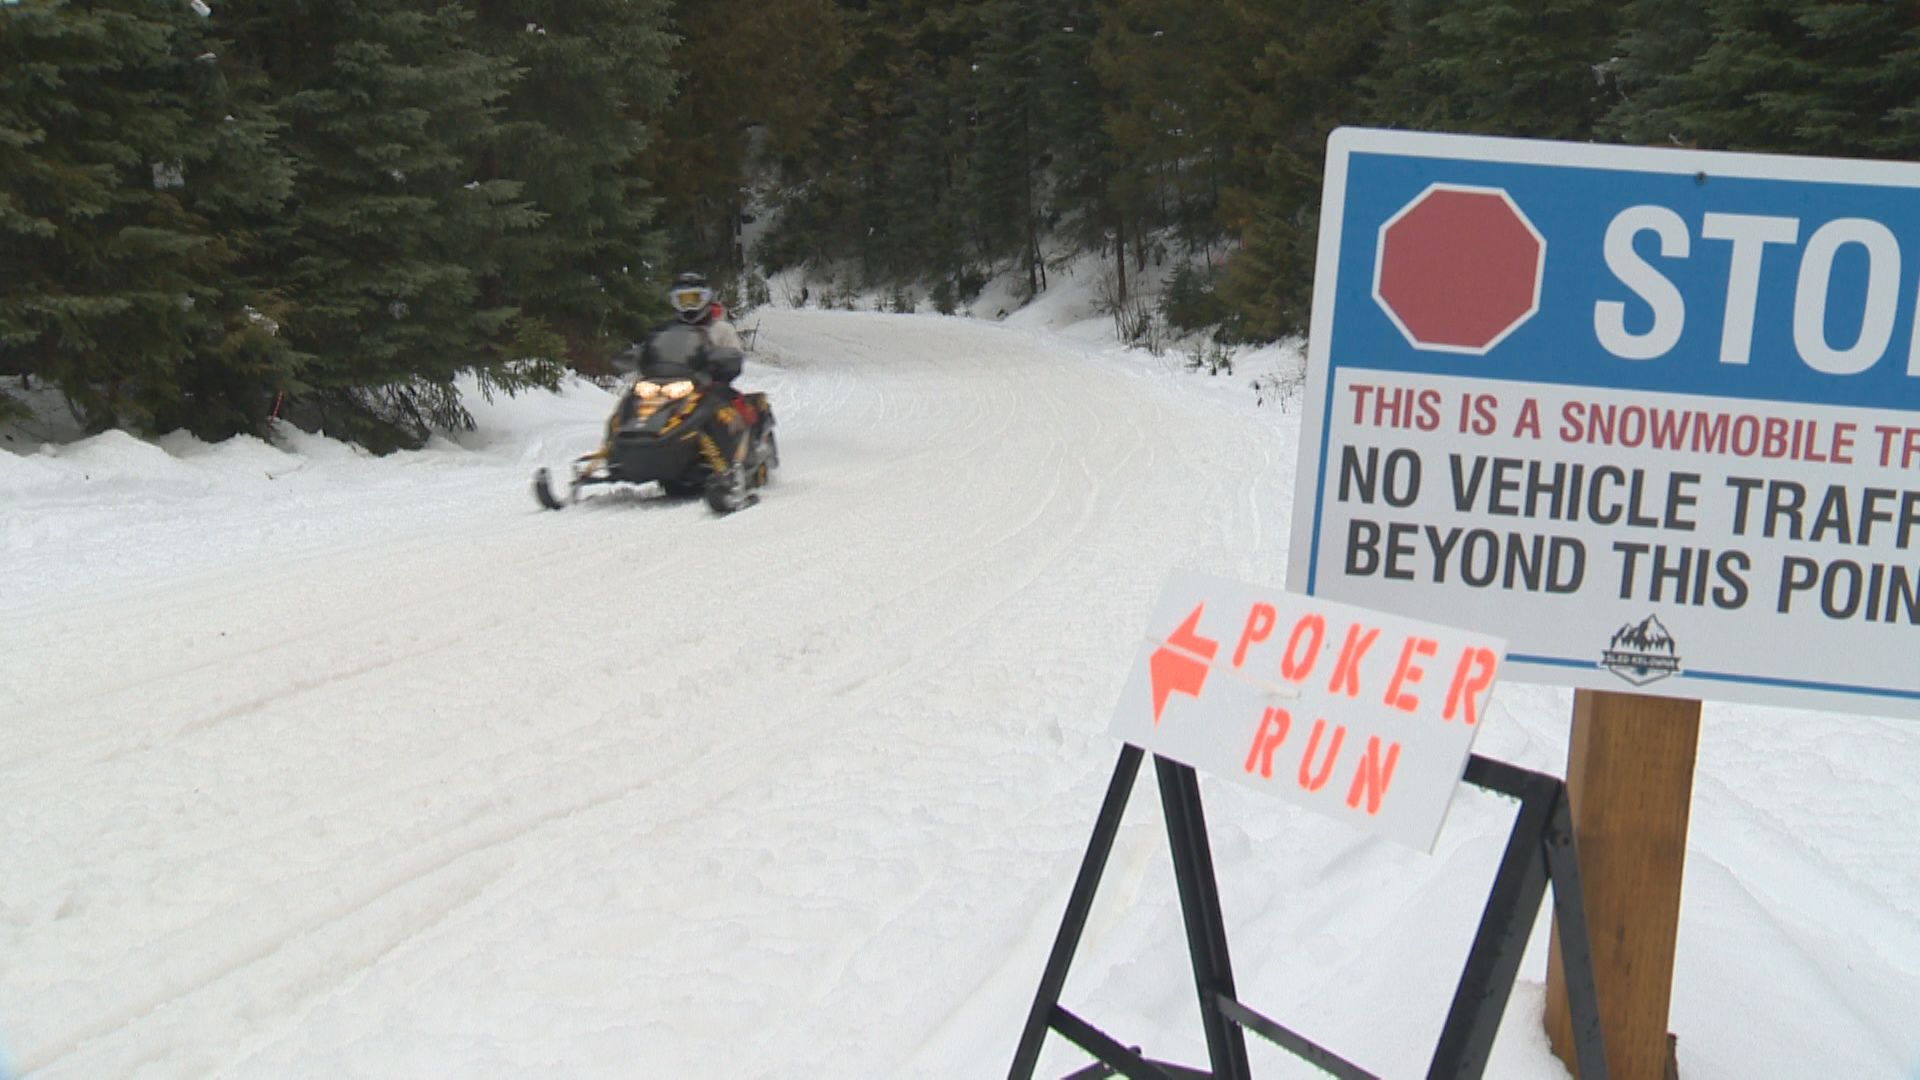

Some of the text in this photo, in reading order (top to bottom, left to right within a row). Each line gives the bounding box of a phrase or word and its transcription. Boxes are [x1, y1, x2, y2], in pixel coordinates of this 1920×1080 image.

[1594, 206, 1920, 376] STO
[1350, 384, 1440, 431] THIS
[1460, 393, 1498, 435] IS
[1514, 399, 1541, 439] A
[1559, 401, 1856, 464] SNOWMOBILE
[1339, 446, 1421, 507] NO
[1450, 454, 1700, 530] VEHICLE
[1346, 520, 1920, 624] BEYOND THIS POIN
[1232, 603, 1496, 725] POKER
[1244, 707, 1400, 815] RUN
